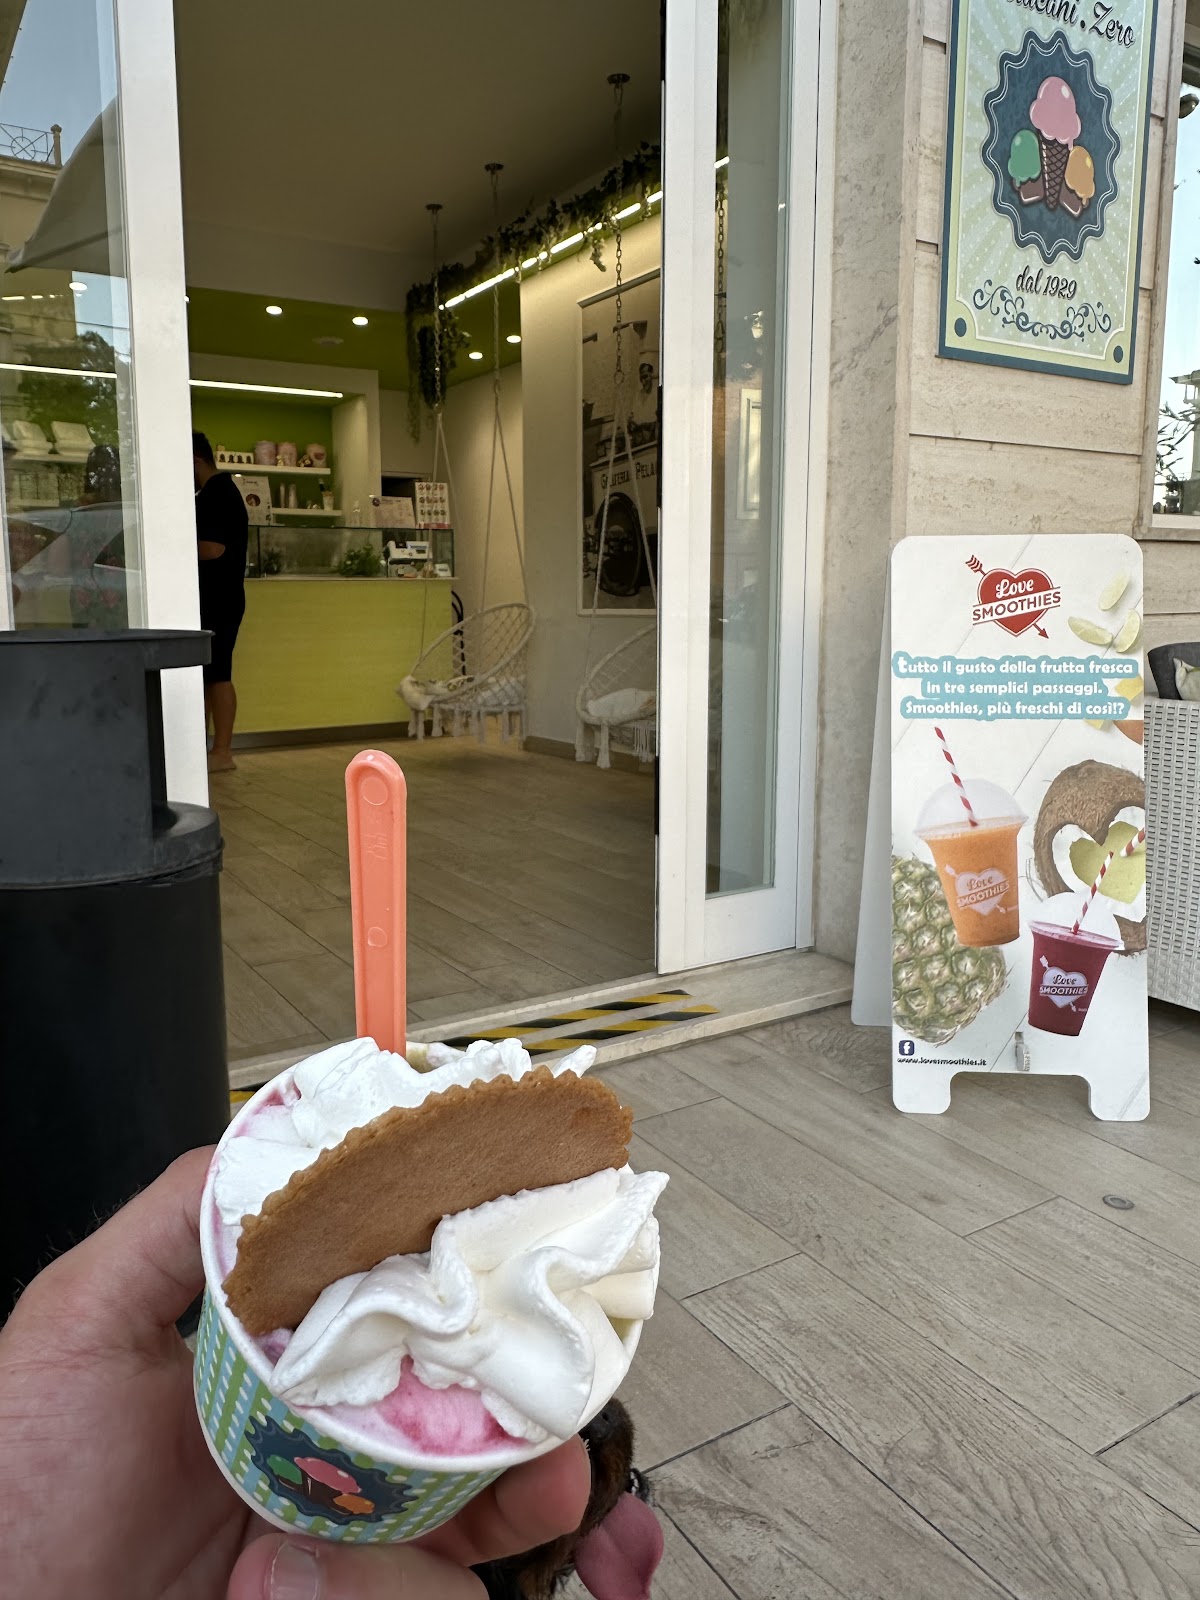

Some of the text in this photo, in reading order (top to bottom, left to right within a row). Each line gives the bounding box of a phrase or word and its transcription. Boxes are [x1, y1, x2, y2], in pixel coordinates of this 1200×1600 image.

[1016, 265, 1077, 300] dal 1929
[996, 579, 1034, 598] Love
[972, 592, 1061, 621] SMOOTHIES
[898, 656, 1133, 675] tutto il gusto della frutta fresca
[927, 680, 1103, 695] in tre semplici passaggi.
[906, 701, 1125, 716] Smoothies, più freschi di così!?
[967, 876, 993, 891] Love
[1053, 975, 1077, 985] Love
[1039, 986, 1088, 995] SMOOTHIES
[897, 1057, 987, 1066] www.lovesmoothies.it
